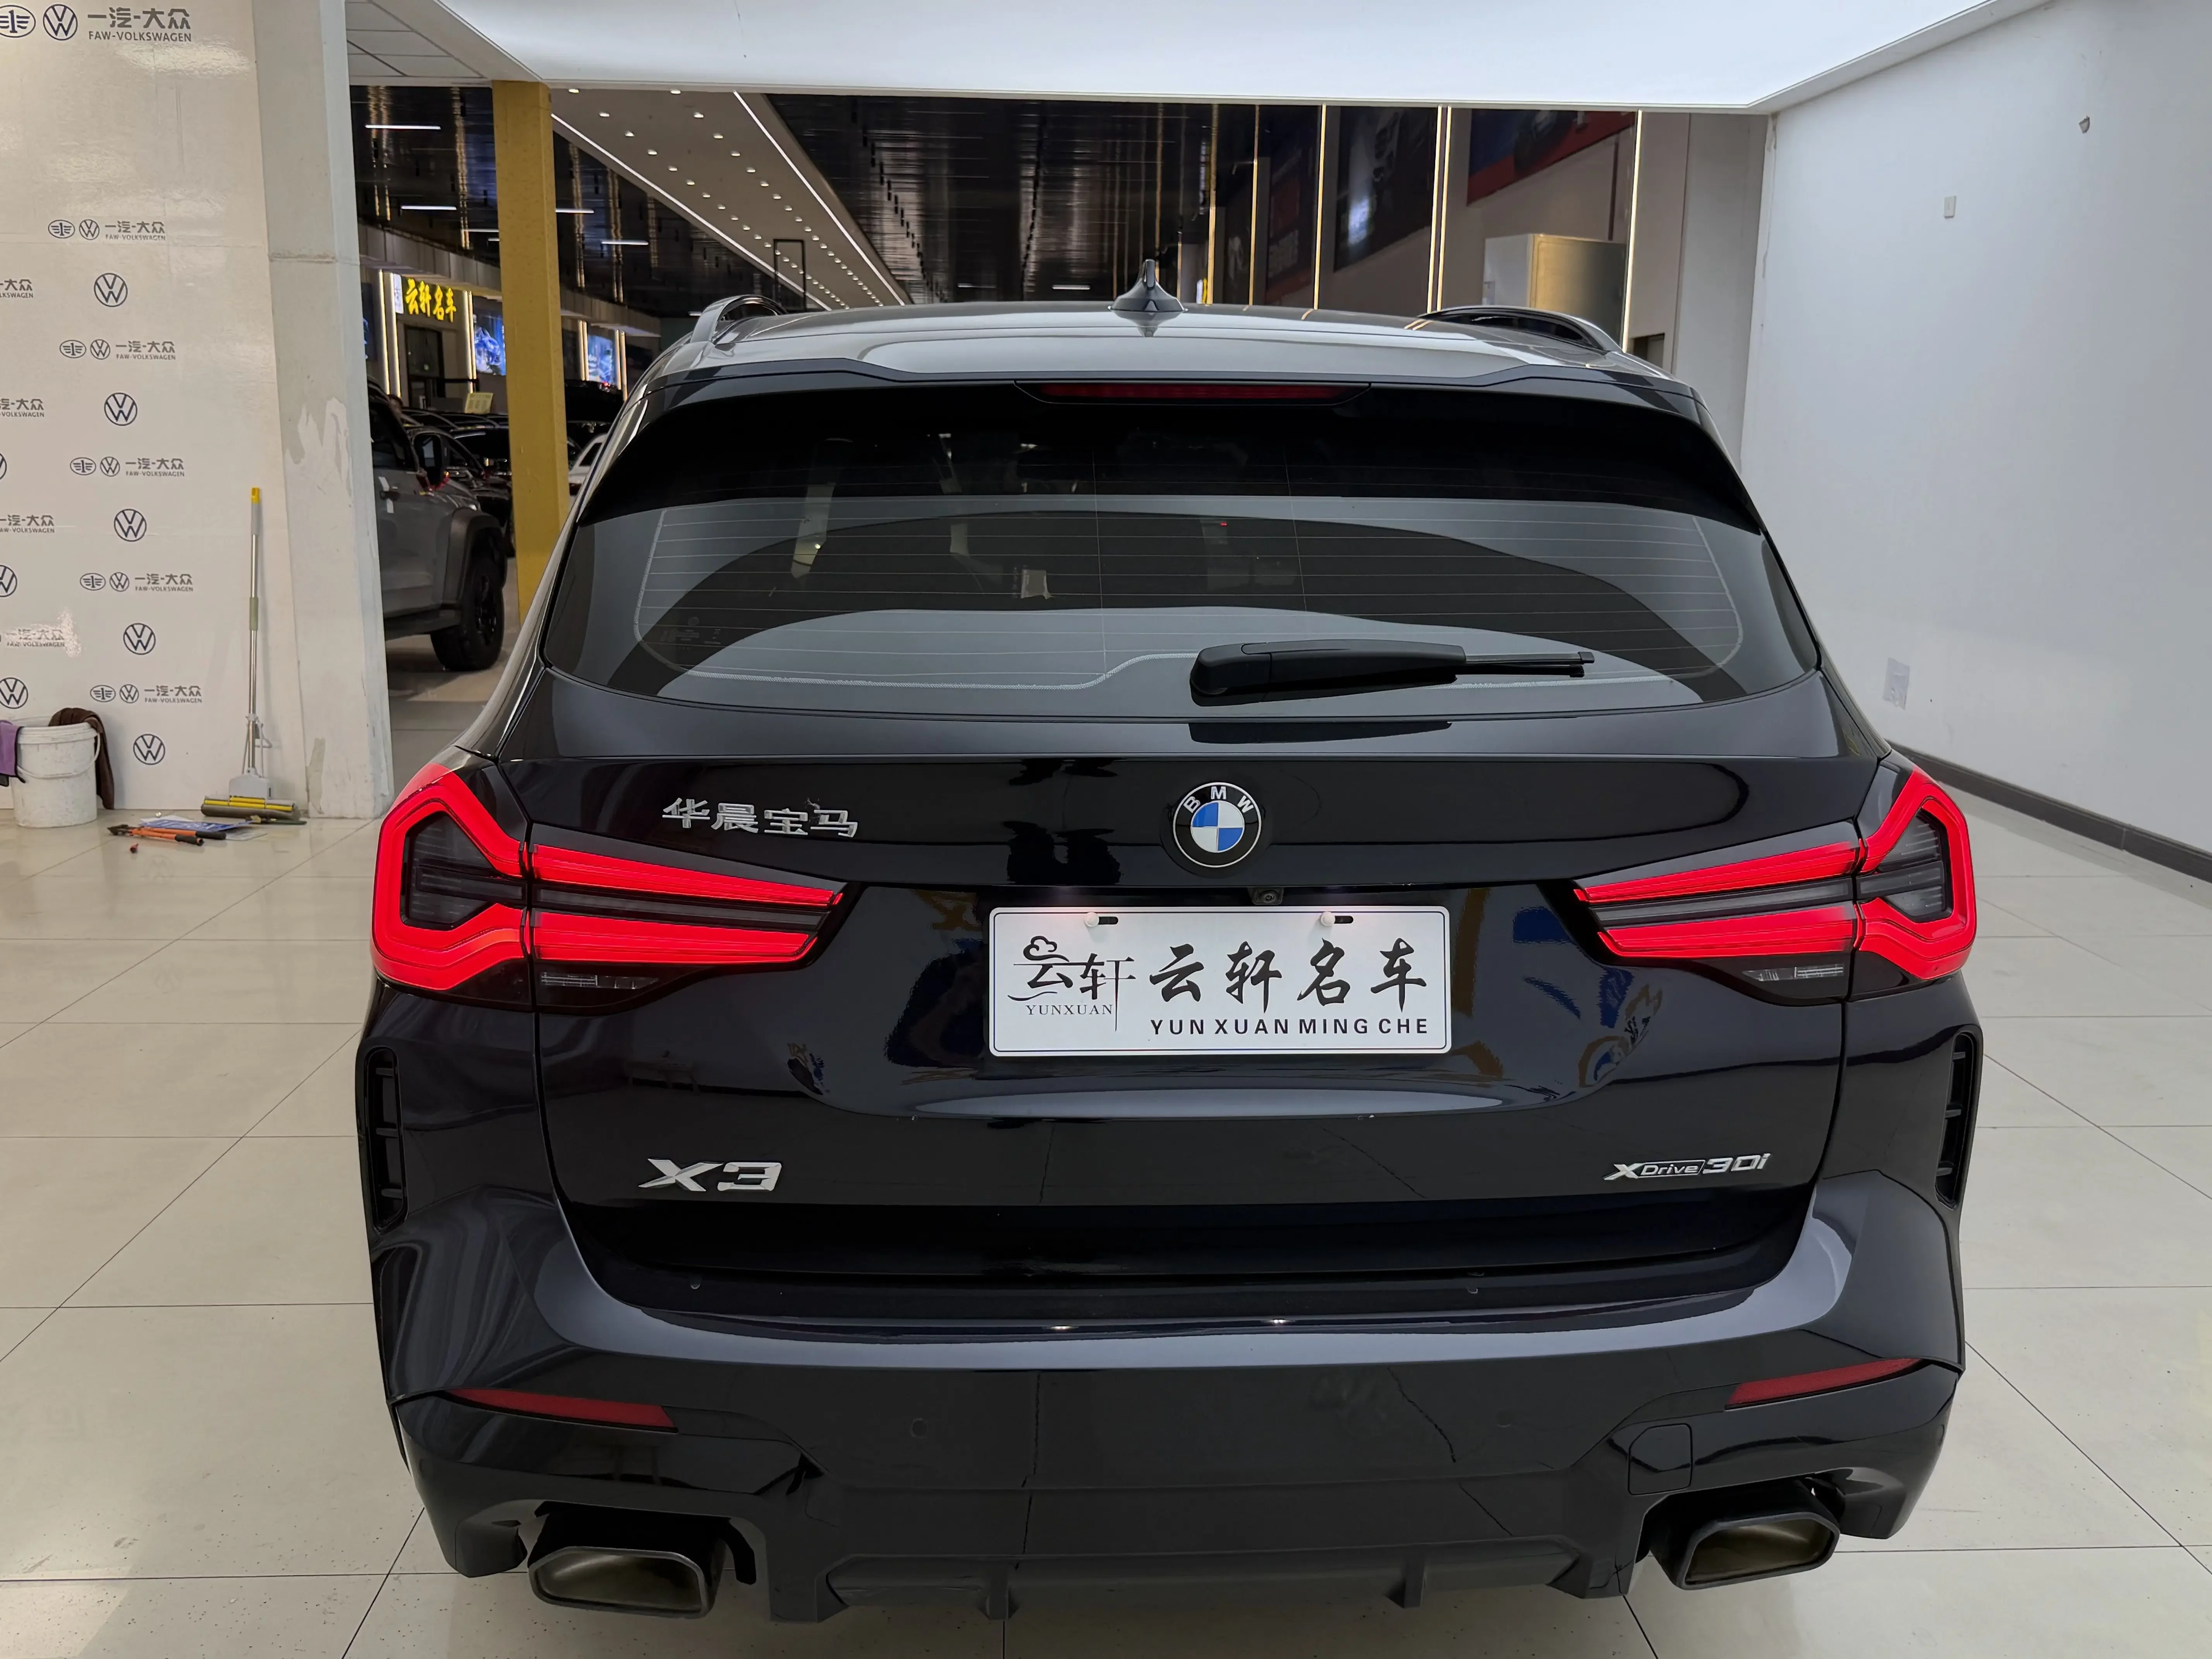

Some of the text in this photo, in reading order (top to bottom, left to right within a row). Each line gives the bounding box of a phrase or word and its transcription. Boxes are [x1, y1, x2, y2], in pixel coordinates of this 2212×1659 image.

[88, 7, 191, 29] 一汽-大众
[89, 31, 191, 42] FAW-VOLKSWAGEN
[105, 221, 165, 233] 一汽-大众
[405, 278, 457, 323] 云轩名车
[116, 341, 175, 353] 一汽-大众
[125, 458, 184, 470] 一汽-大众
[135, 574, 193, 585] 一汽-大众
[144, 685, 201, 697] 一汽-大众
[1183, 786, 1254, 814] BMW
[662, 797, 858, 837] 华晨宝马
[1008, 936, 1136, 1032] 云轩
[1149, 938, 1427, 1014] 云轩名车
[1025, 1004, 1113, 1015] YUNXUAN
[1151, 1018, 1427, 1035] YUN XUAN MING CHE
[638, 1158, 782, 1192] X3
